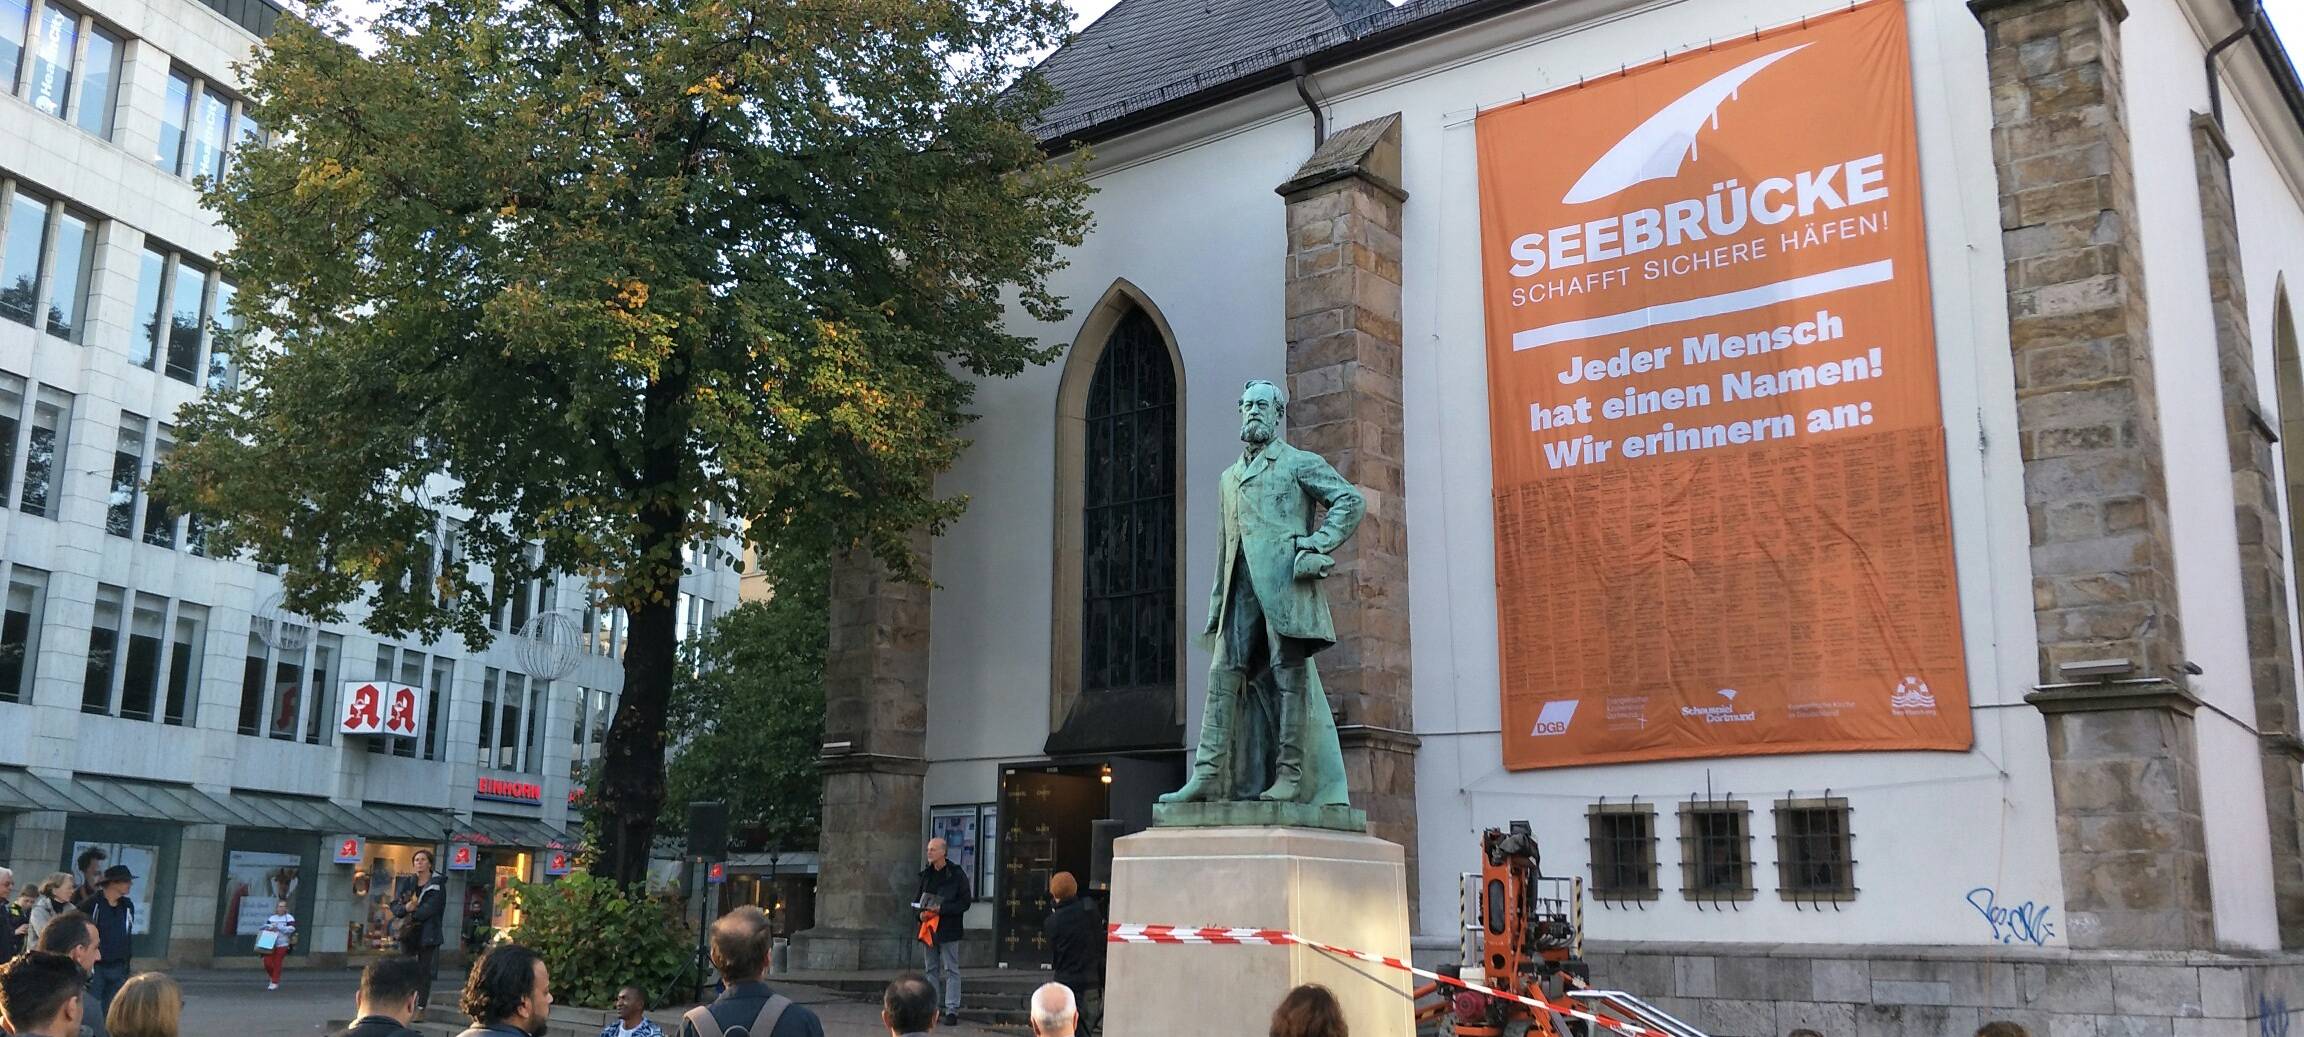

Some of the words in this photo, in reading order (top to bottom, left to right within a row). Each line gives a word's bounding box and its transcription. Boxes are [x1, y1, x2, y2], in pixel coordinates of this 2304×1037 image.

[1508, 154, 1889, 277] SEEBRÜCKE
[1512, 267, 1630, 306] SCHAFFT
[1644, 238, 1767, 280] SICHERE
[1781, 211, 1888, 252] HÄFEN!
[1558, 347, 1671, 384] Jeder
[1682, 310, 1843, 365] Mensch
[1530, 397, 1592, 431] hat
[1602, 383, 1710, 420] einen
[1722, 347, 1882, 402] Namen!
[1543, 435, 1612, 469] Wir
[1622, 414, 1796, 457] erinnern
[1806, 401, 1873, 433] an:
[1537, 721, 1565, 734] DGB
[1706, 711, 1756, 723] Dortmund
[478, 777, 541, 800] EINHORN
